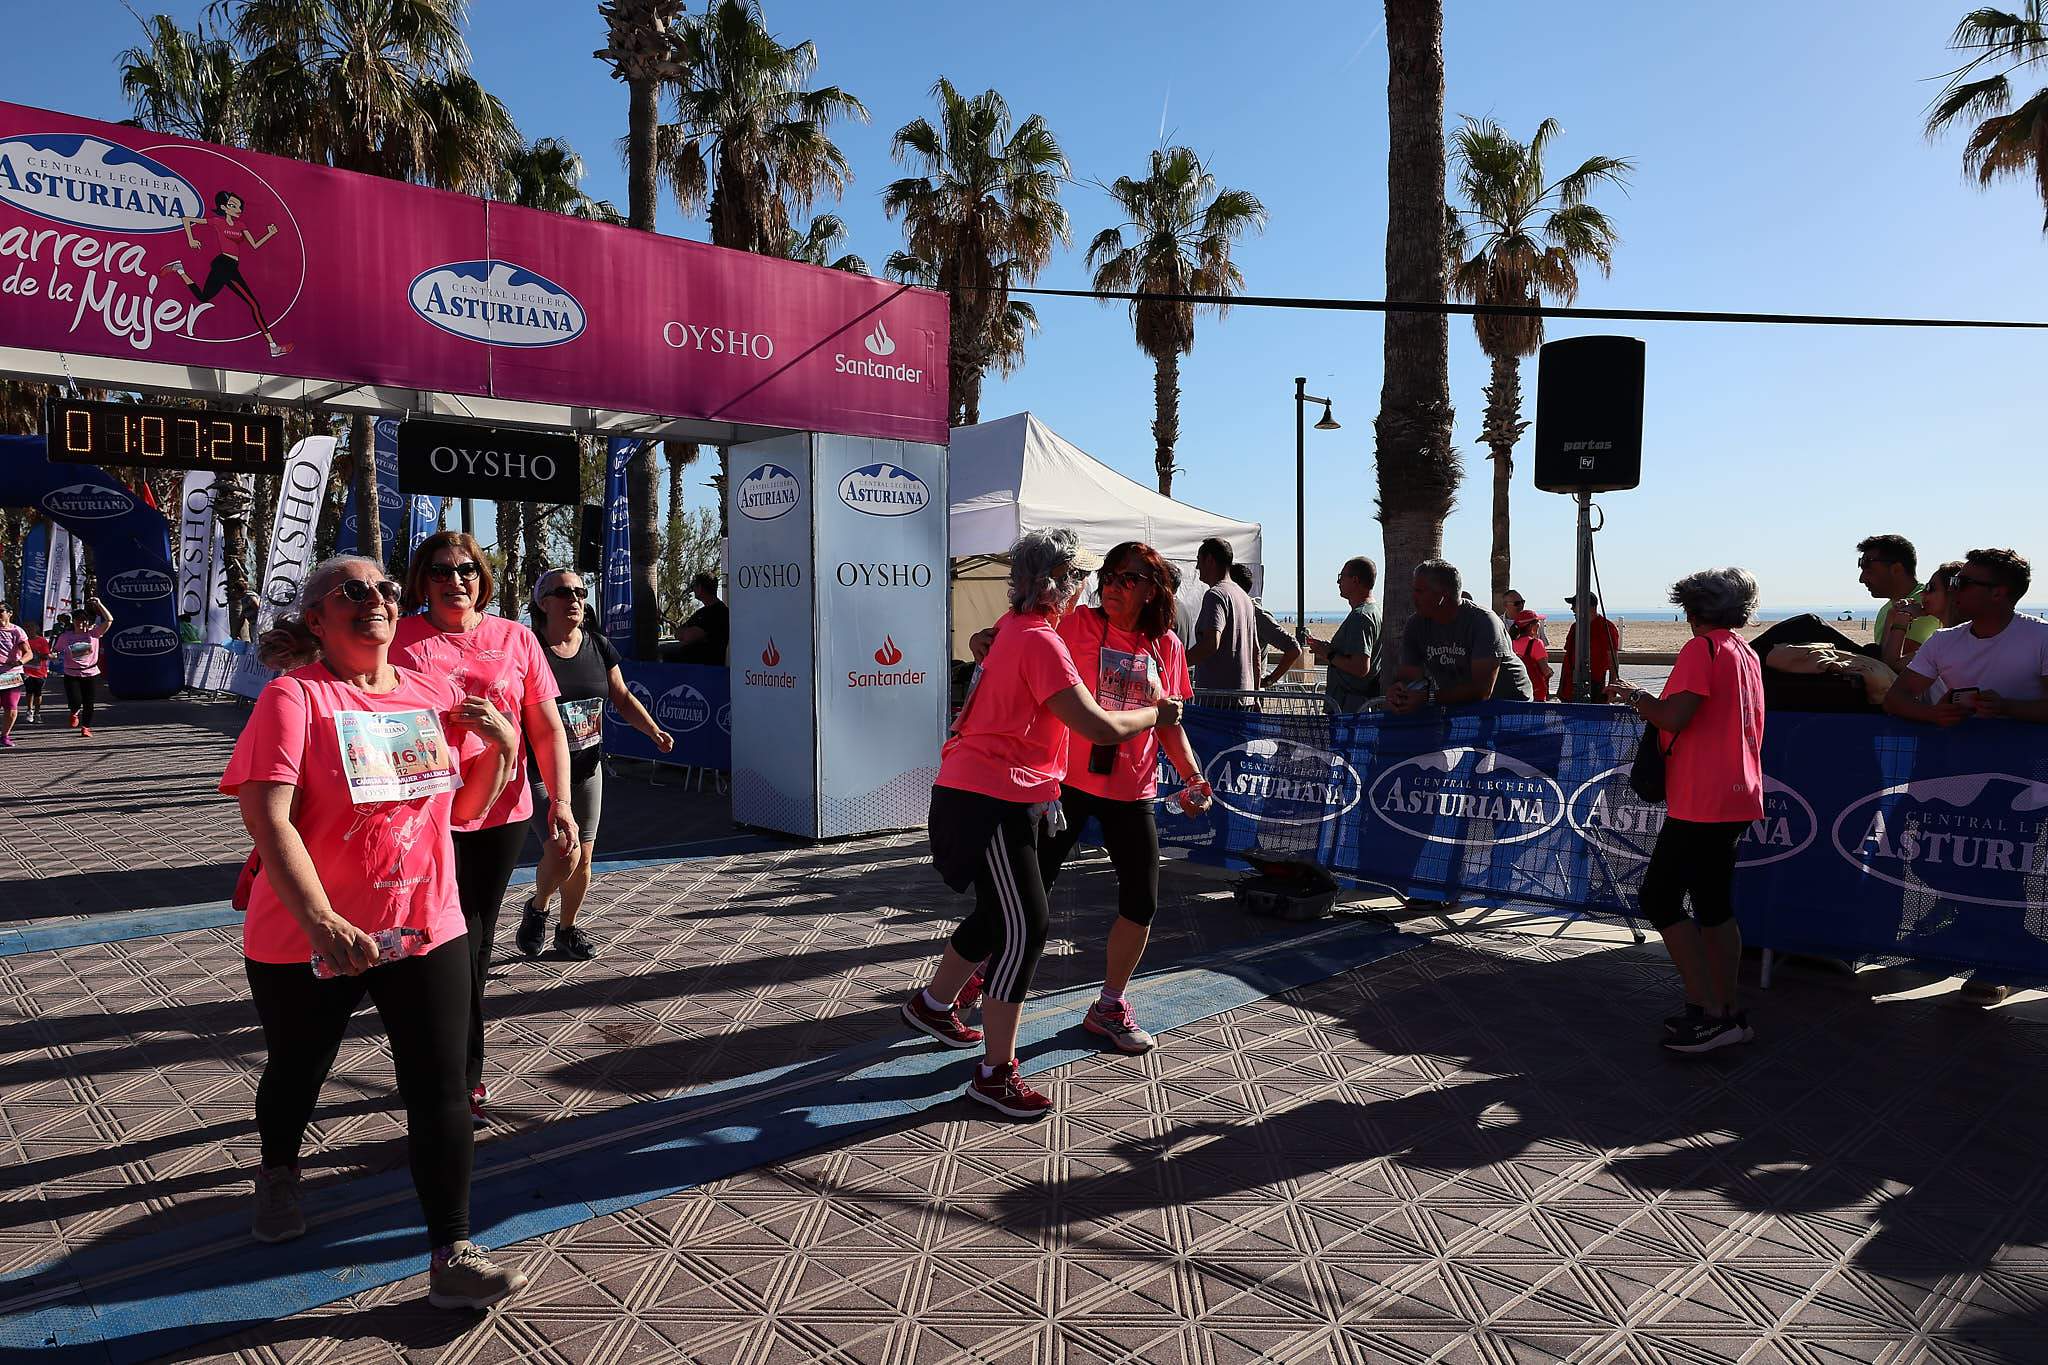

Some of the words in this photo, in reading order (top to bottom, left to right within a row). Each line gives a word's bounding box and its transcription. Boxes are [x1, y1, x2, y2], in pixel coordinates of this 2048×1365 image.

[0, 154, 185, 219] ASTURIANA
[27, 156, 101, 178] CENTRAL
[109, 172, 180, 193] LECHERA
[0, 226, 147, 277] arrera
[2, 261, 39, 296] de
[47, 266, 73, 302] la
[69, 270, 215, 350] Mujer
[424, 282, 574, 332] ASTURIANA
[452, 283, 508, 299] CENTRAL
[513, 293, 568, 308] LECHERA
[663, 321, 774, 360] OYSHO
[834, 353, 922, 384] Santander
[66, 410, 266, 462] 01:07:24
[430, 446, 556, 481] OYSHO
[50, 499, 129, 511] ASTURIANA
[740, 487, 795, 508] ASTURIANA
[845, 480, 923, 505] ASTURIANA
[267, 461, 322, 607] OYSHO
[184, 488, 211, 616] OYSHO
[28, 551, 46, 595] Marlene
[111, 580, 172, 593] ASTURIANA
[739, 562, 800, 589] OYSHO
[836, 562, 931, 587] OYSHO
[116, 636, 176, 649] ASTURIANA
[745, 669, 797, 688] Santander
[848, 669, 926, 688] Santander
[659, 702, 703, 722] ASTURIANA
[1240, 759, 1288, 775] CENTRAL
[1214, 761, 1346, 805] ASTURIANA
[1414, 777, 1472, 789] CENTRAL
[1478, 781, 1543, 793] LECHERA
[1380, 776, 1548, 825] ASTURIANA
[1906, 811, 2006, 832] CENTRAL
[1852, 810, 2048, 874] ASTURI
